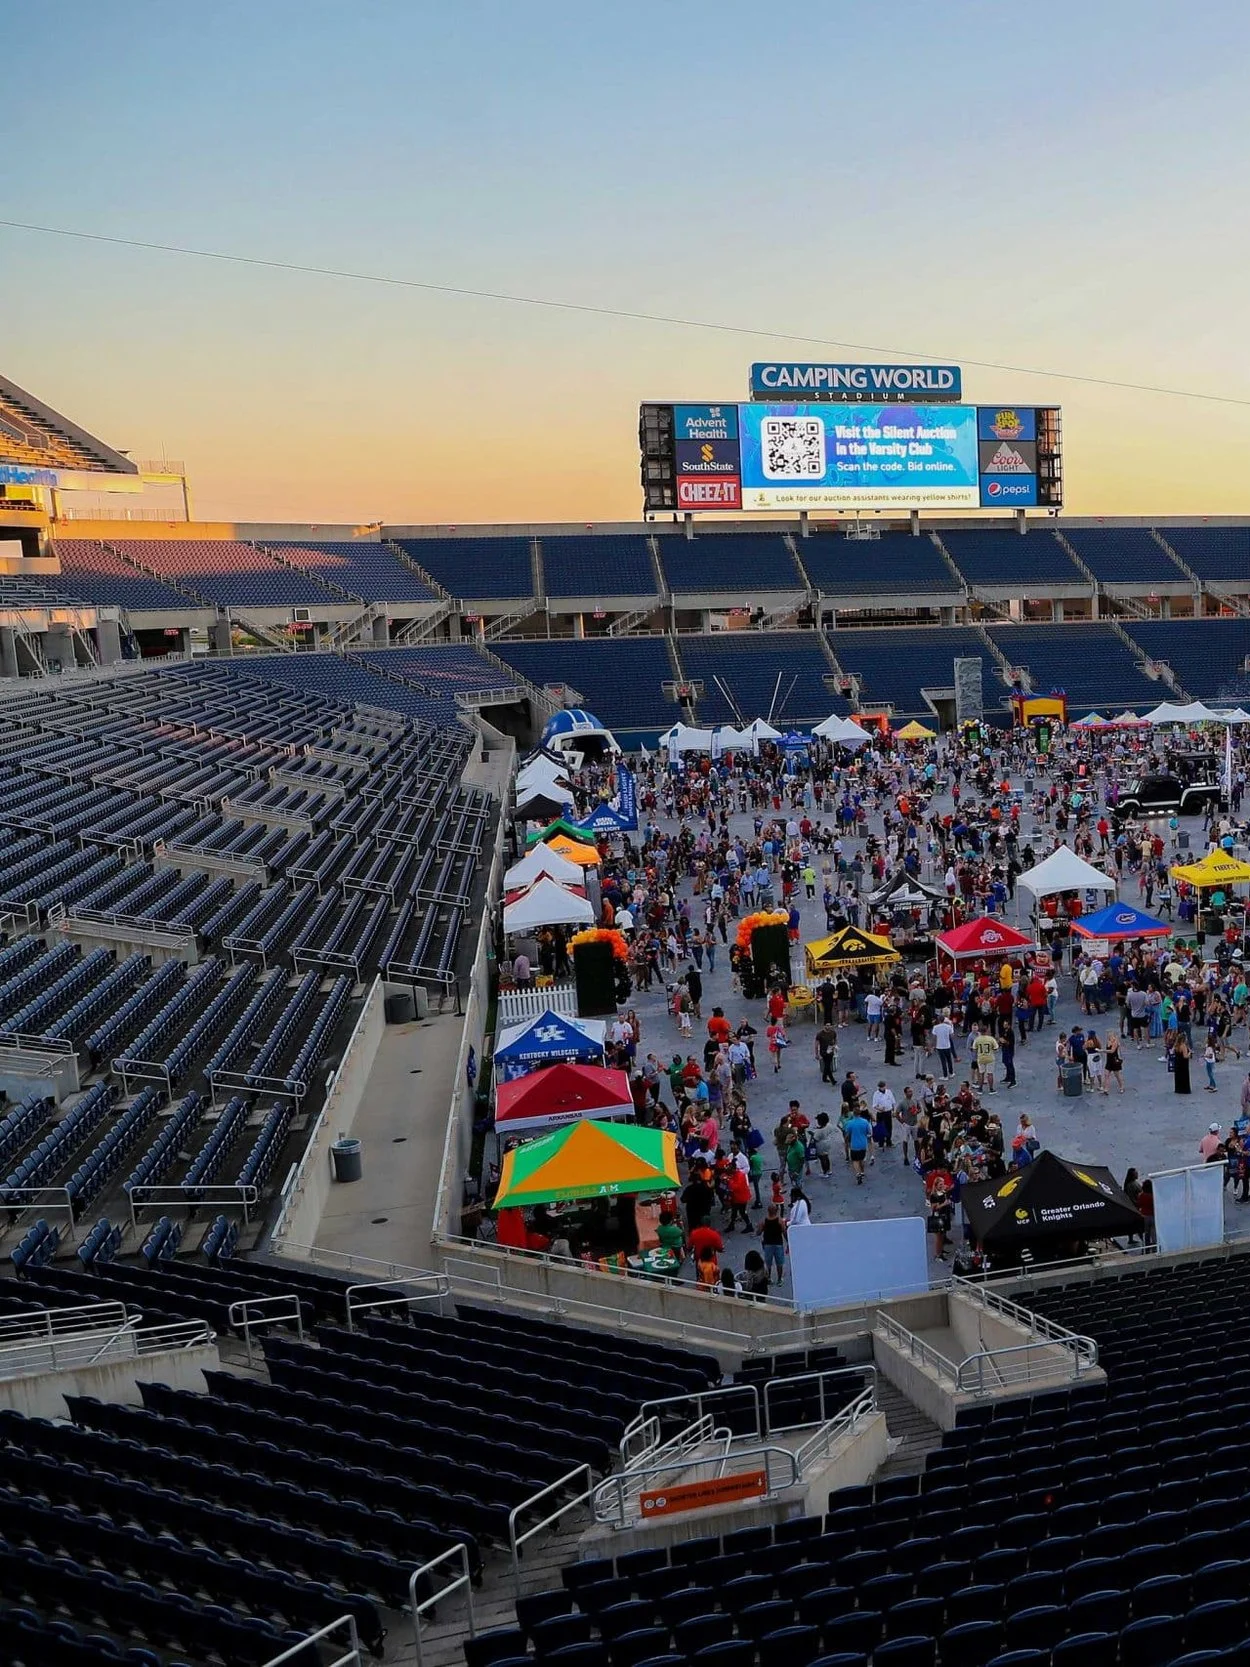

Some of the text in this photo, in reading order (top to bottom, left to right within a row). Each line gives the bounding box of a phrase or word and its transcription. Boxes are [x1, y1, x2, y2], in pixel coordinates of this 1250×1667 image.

[761, 366, 954, 389] CAMPING WORLD
[814, 391, 905, 400] STADIUM
[686, 417, 727, 427] Advent
[689, 428, 727, 439] Health
[835, 425, 956, 439] Visit the Silent Auction
[848, 442, 867, 455] the
[869, 442, 907, 458] Varsity
[908, 442, 933, 455] Club
[992, 452, 1024, 465] Coors
[682, 461, 734, 471] SouthState
[836, 462, 956, 471] Scan the code. Bid online.
[1002, 485, 1030, 495] pepsi
[776, 494, 795, 502] Look
[796, 494, 807, 502] for
[824, 494, 851, 502] auction
[852, 494, 889, 502] assistants
[891, 494, 921, 503] wearing
[922, 494, 946, 503] yellow
[519, 1049, 579, 1060] KENTUCKY WILDCATS
[1041, 1201, 1105, 1215] Greater Orlando
[1042, 1212, 1073, 1222] Knights
